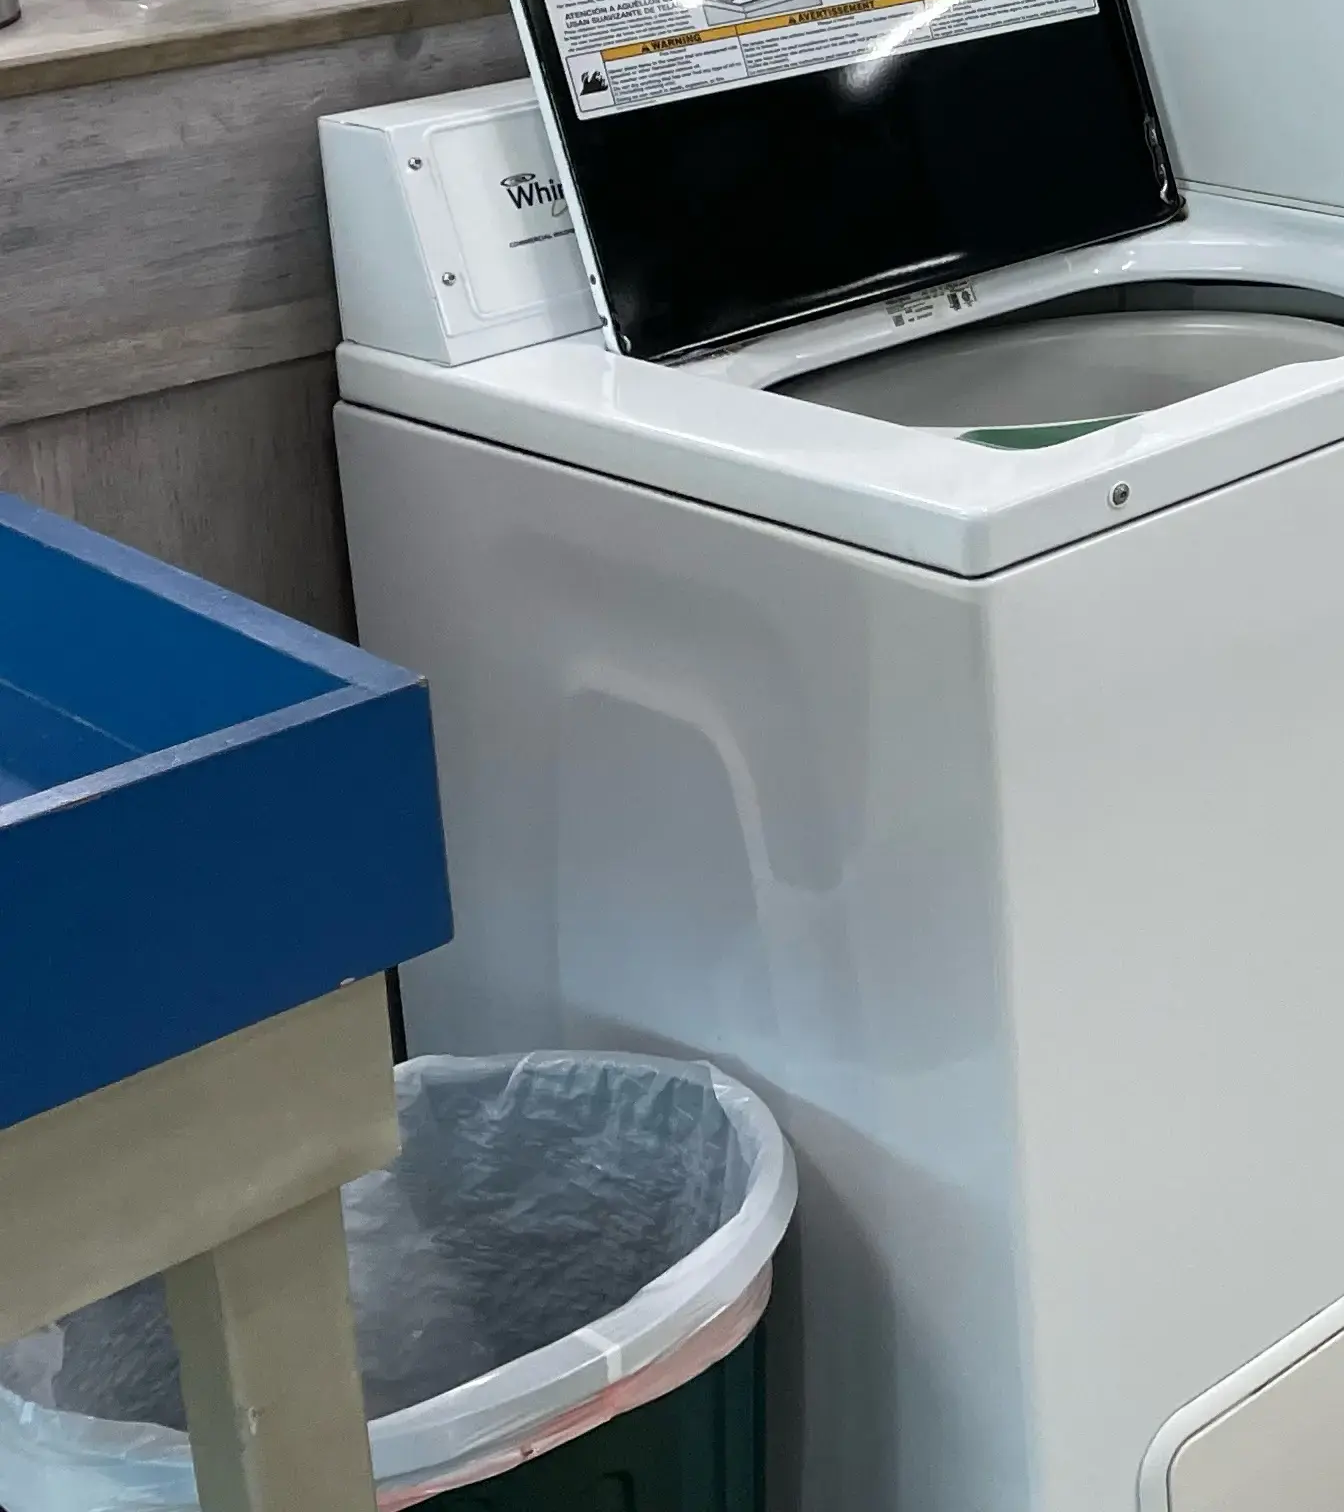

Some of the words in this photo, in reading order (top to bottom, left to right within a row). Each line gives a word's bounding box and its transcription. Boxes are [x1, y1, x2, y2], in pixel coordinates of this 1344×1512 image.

[609, 4, 616, 12] A
[799, 0, 875, 22] AVERTISSEMENT
[566, 18, 590, 29] USAN
[644, 7, 655, 15] DE
[651, 33, 702, 49] WARNING
